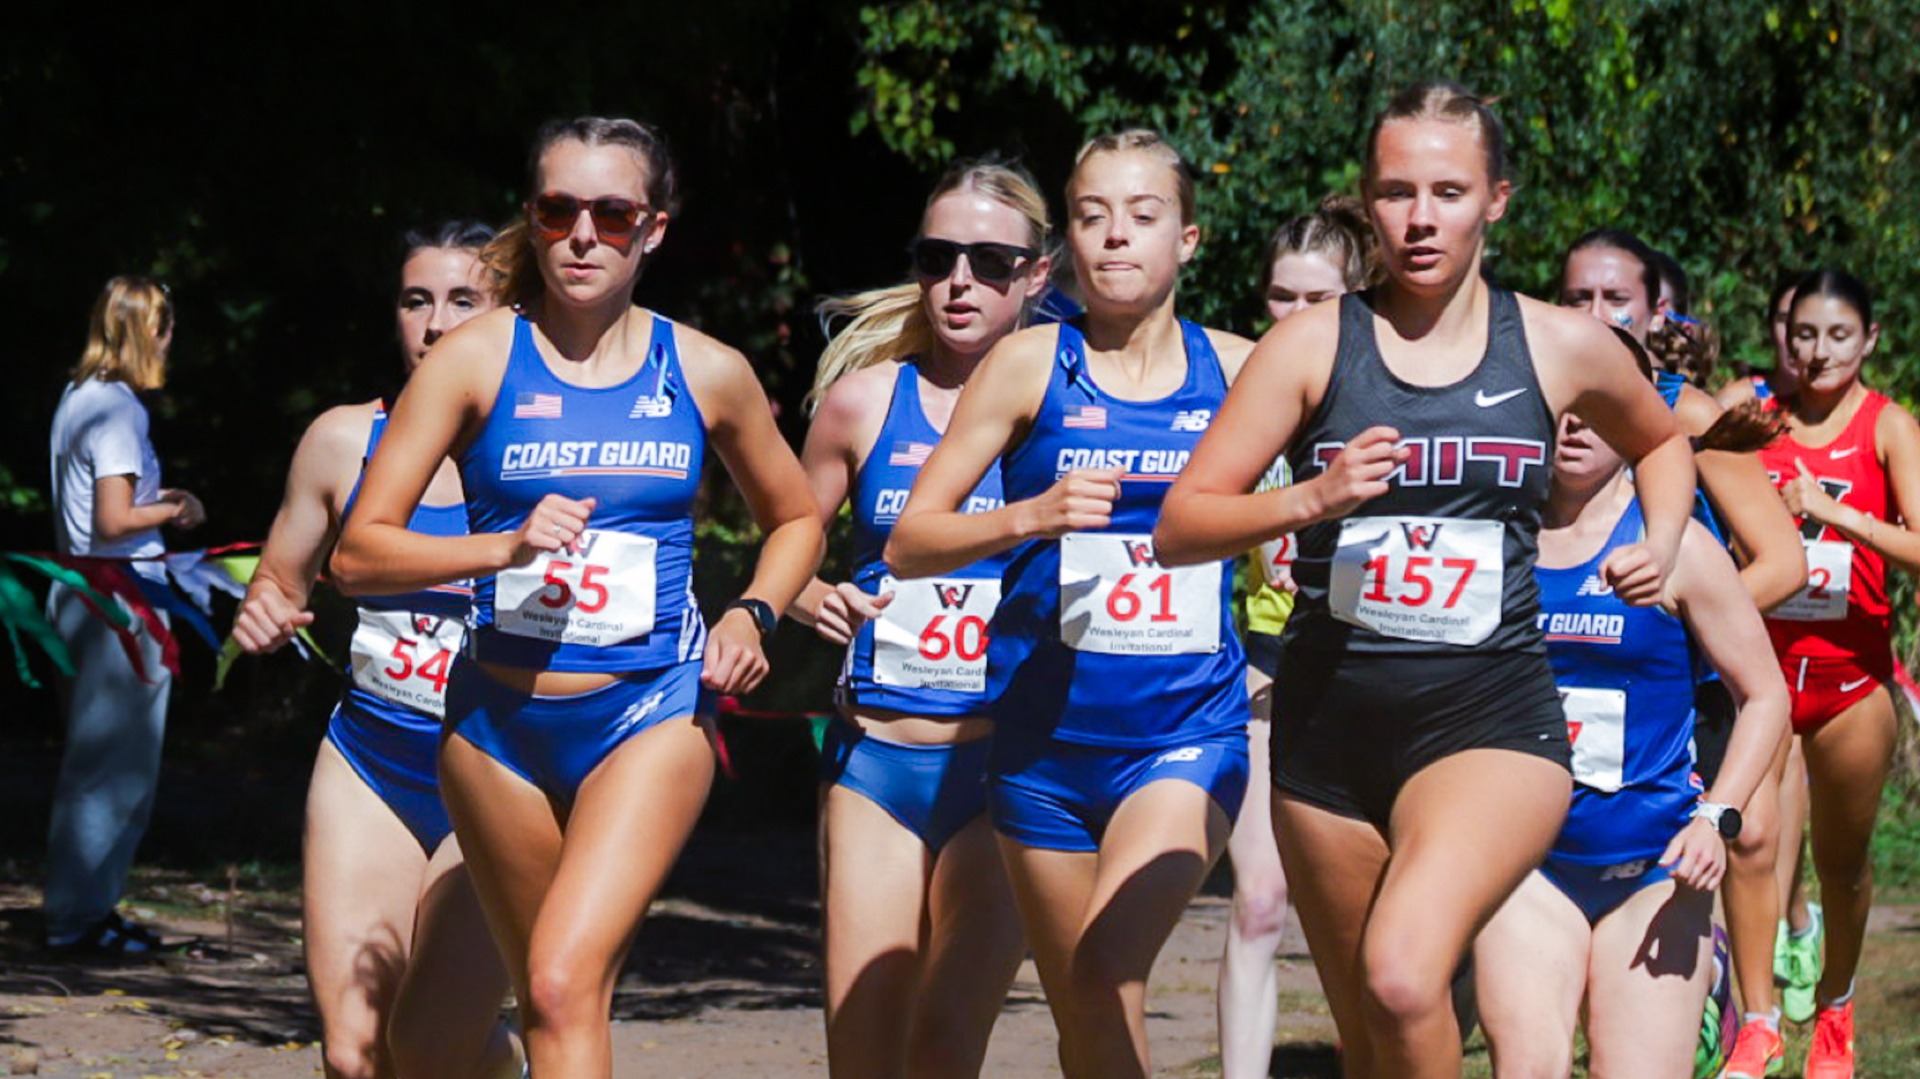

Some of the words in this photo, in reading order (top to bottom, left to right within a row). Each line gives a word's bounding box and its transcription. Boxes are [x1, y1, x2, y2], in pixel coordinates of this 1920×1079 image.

[502, 441, 598, 471] COAST
[599, 441, 691, 469] GUARD
[1056, 448, 1140, 473] COAST
[1140, 450, 1191, 473] GUA
[538, 560, 610, 614] 55
[1361, 554, 1478, 609] 157
[1106, 573, 1178, 622] 61
[522, 610, 575, 626] Wesleyan
[576, 618, 624, 632] Cardinal
[1358, 605, 1416, 621] Wesleyan
[1419, 613, 1471, 626] Cardinal
[1549, 613, 1625, 637] GUARD
[918, 614, 990, 661] 60
[1089, 627, 1145, 639] Wesleyan
[1147, 628, 1194, 638] Cardinal
[1379, 623, 1447, 638] Invitational
[1110, 641, 1173, 652] Invitational
[384, 636, 449, 693] 54
[902, 662, 953, 677] Wesleyan
